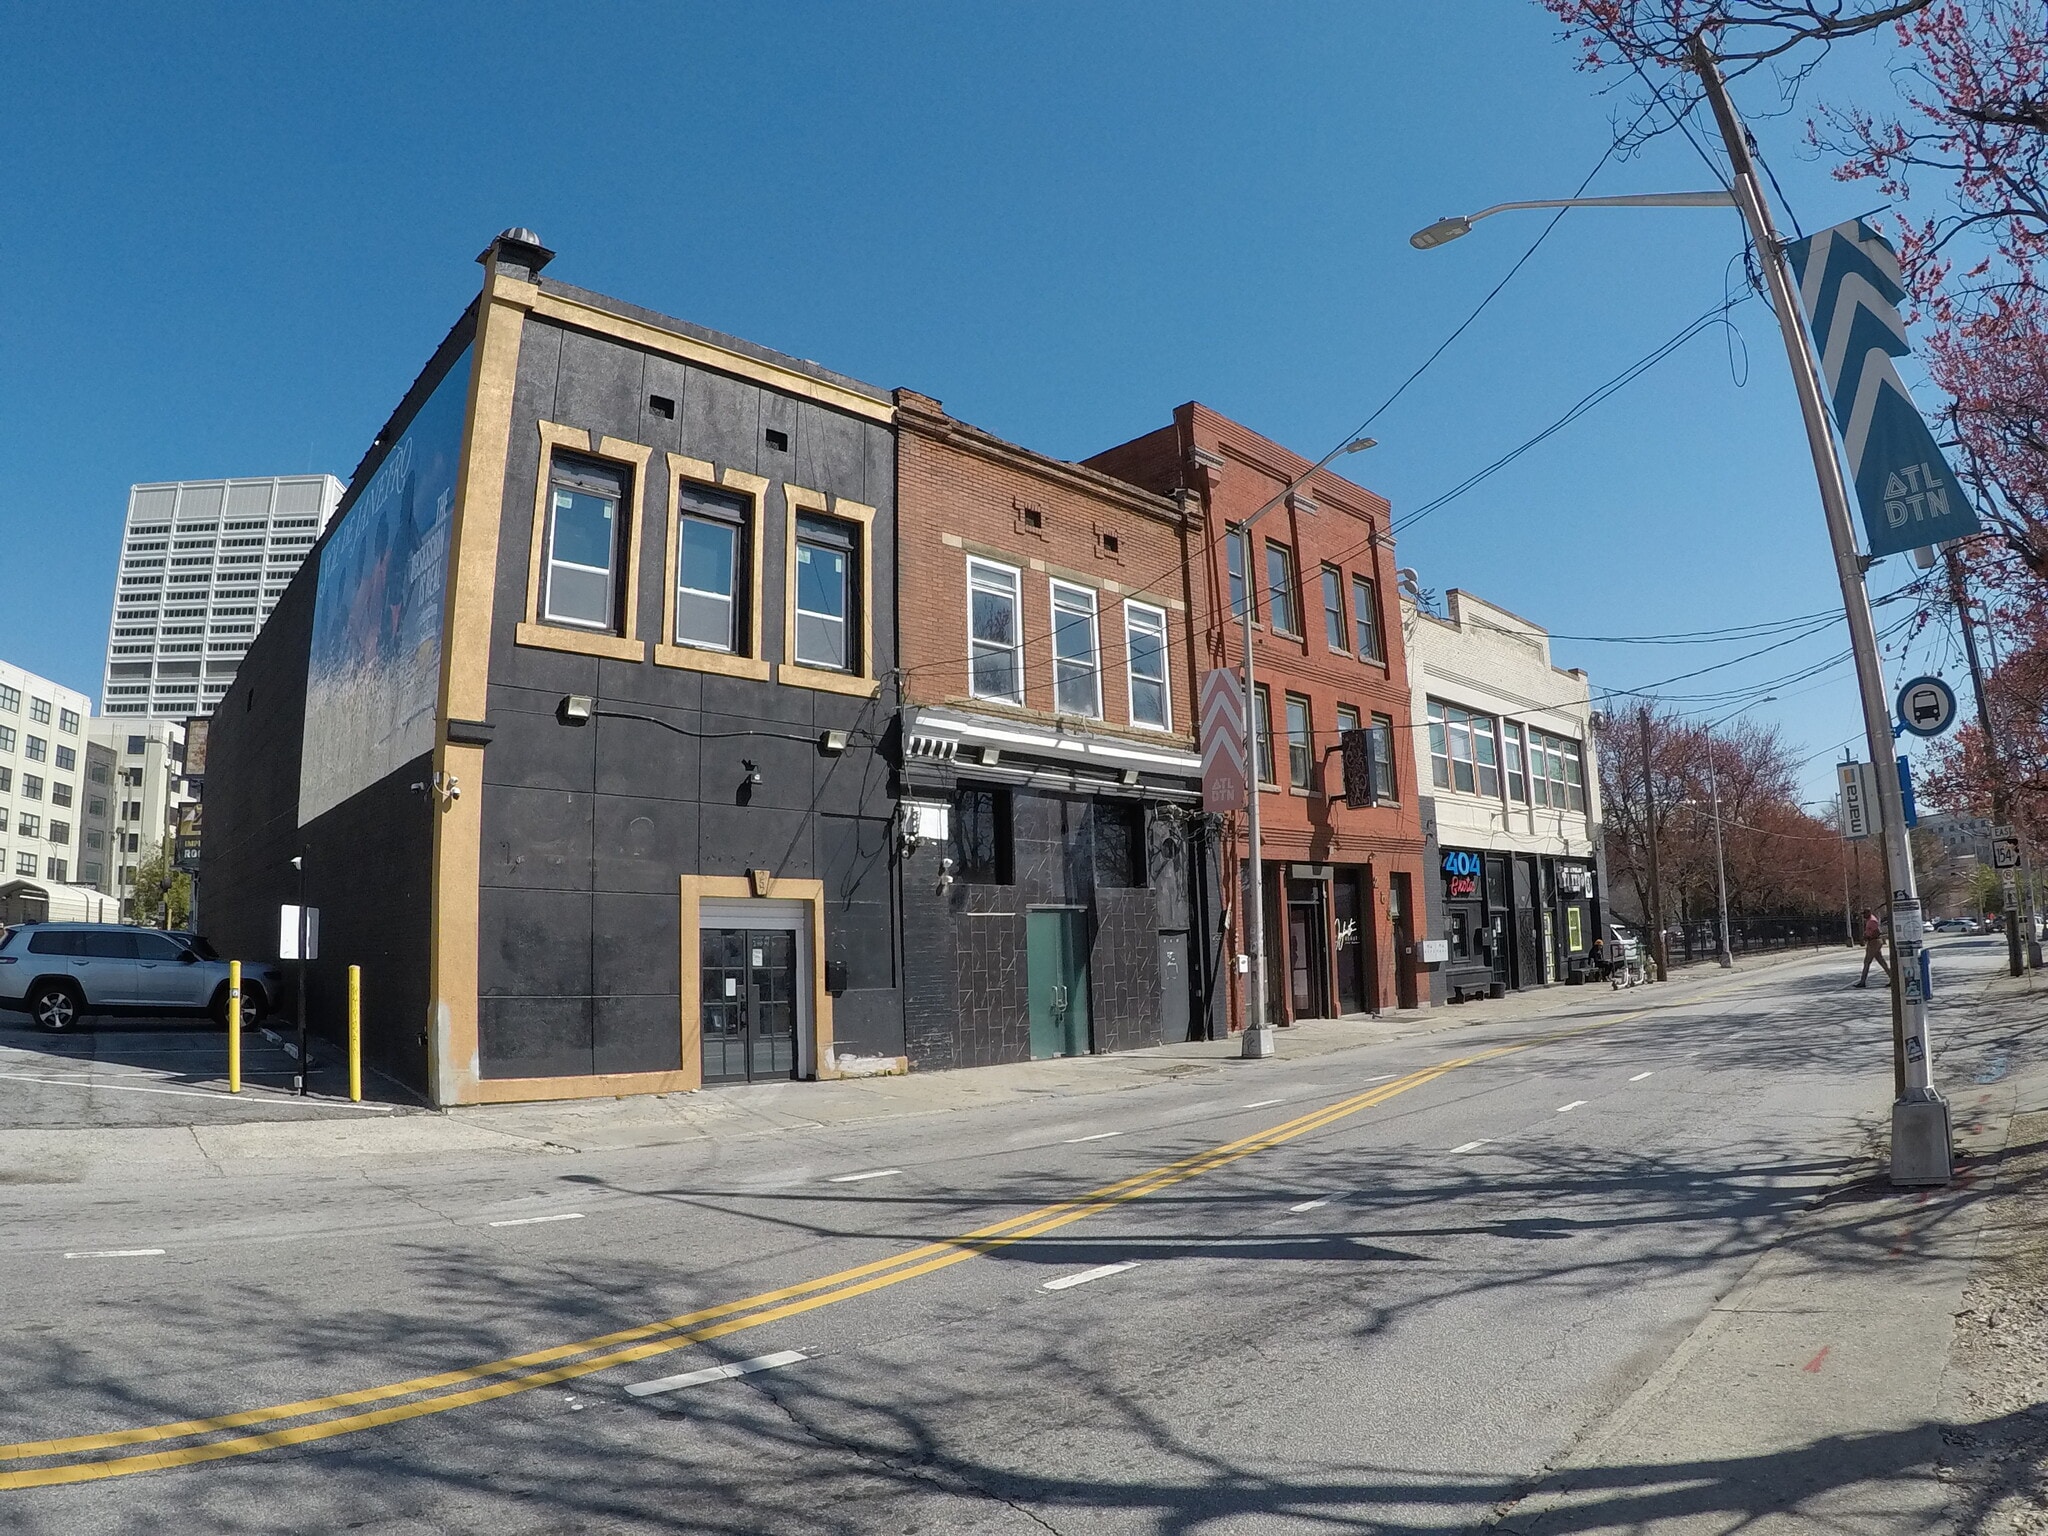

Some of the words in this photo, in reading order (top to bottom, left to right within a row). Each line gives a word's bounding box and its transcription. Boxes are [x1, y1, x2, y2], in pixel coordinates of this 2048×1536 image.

[1883, 462, 1944, 501] ATL
[435, 487, 450, 527] THE
[1884, 488, 1950, 529] DTN
[1212, 778, 1233, 789] ATL
[1212, 789, 1234, 800] DTN
[1846, 784, 1863, 833] marta
[1995, 826, 2013, 837] EAST
[1445, 851, 1481, 876] 404
[1996, 847, 2013, 863] 154
